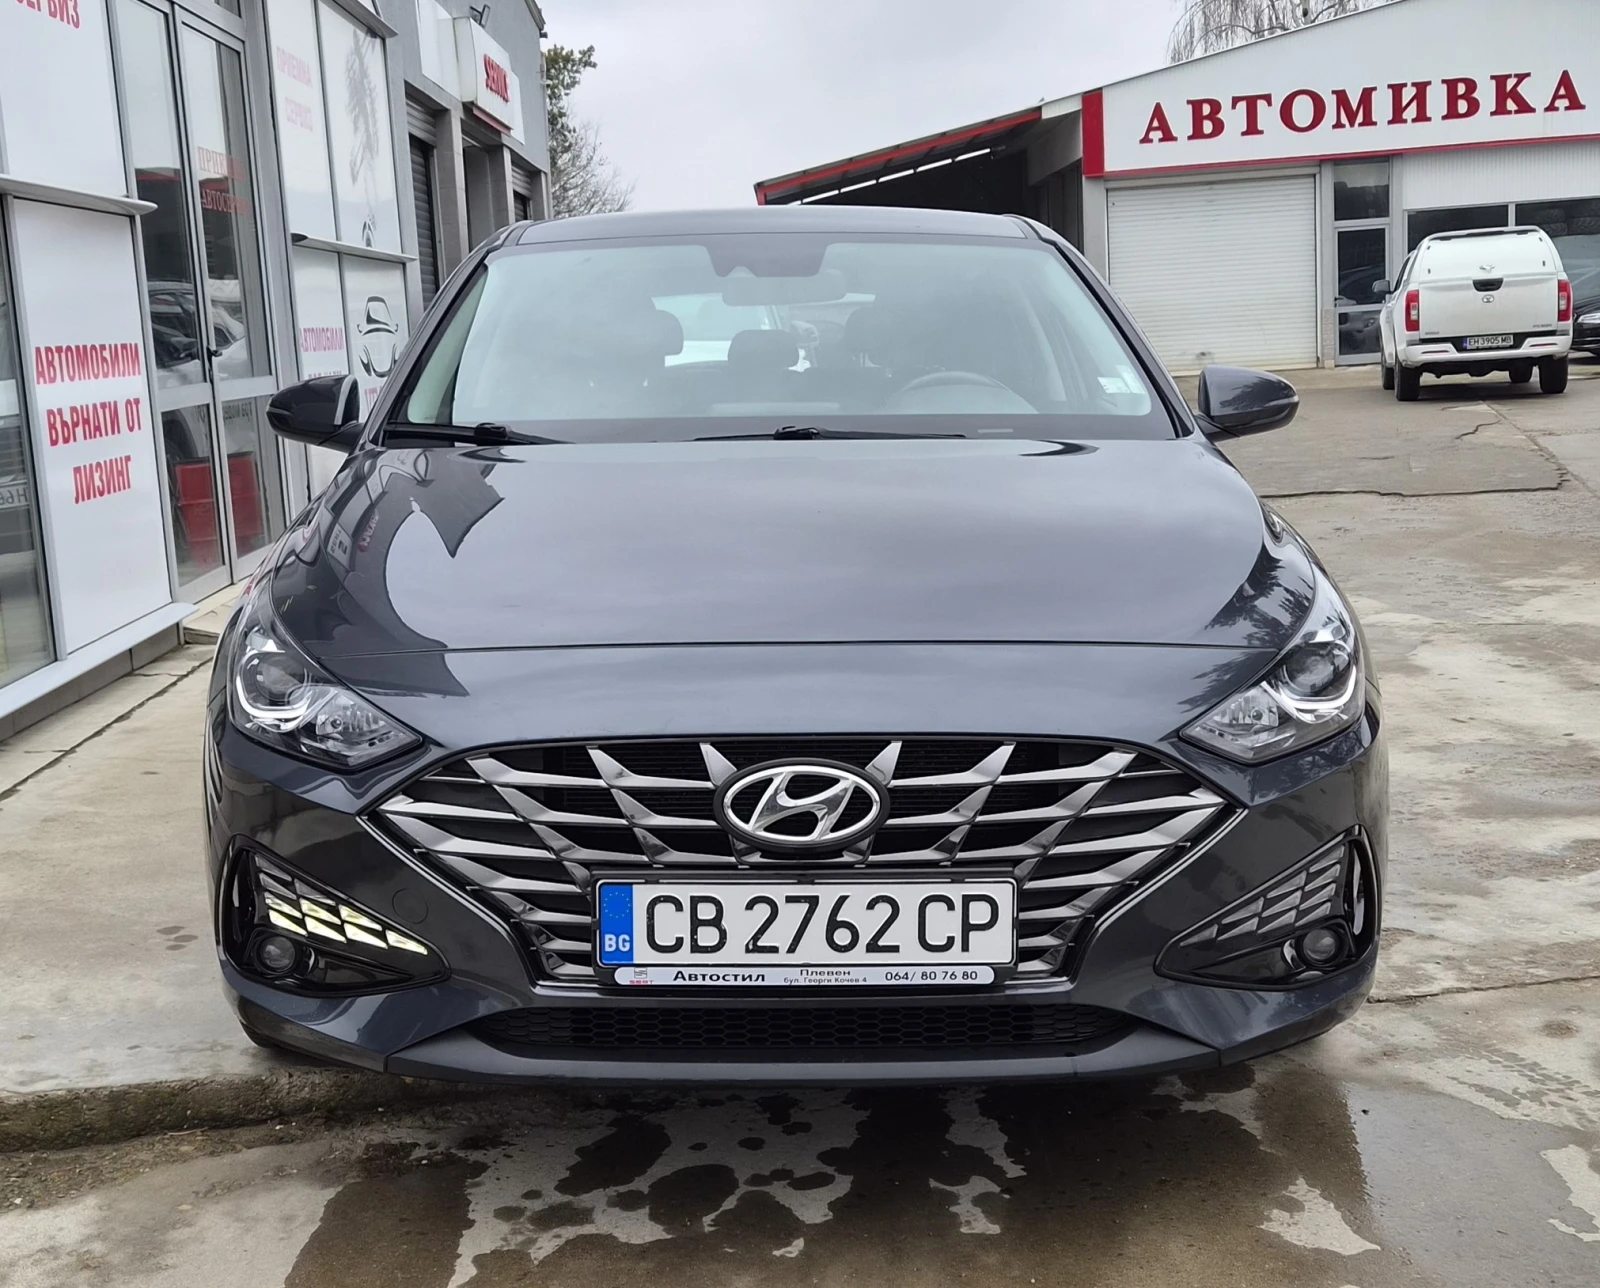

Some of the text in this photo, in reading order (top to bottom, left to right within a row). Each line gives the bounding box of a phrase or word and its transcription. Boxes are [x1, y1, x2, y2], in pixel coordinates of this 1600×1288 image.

[1139, 70, 1586, 144] АВТОМИВКА
[35, 343, 141, 385] АВТОМОБИЛИ
[46, 400, 121, 447] ВЪРНАТИ
[124, 397, 142, 433] ОТ
[73, 455, 132, 504] ЛИЗИНГ
[604, 934, 631, 952] BG
[646, 894, 999, 953] CB 2762 CP
[673, 971, 766, 983] Автостил
[885, 971, 978, 982] 064/ 80 76 80
